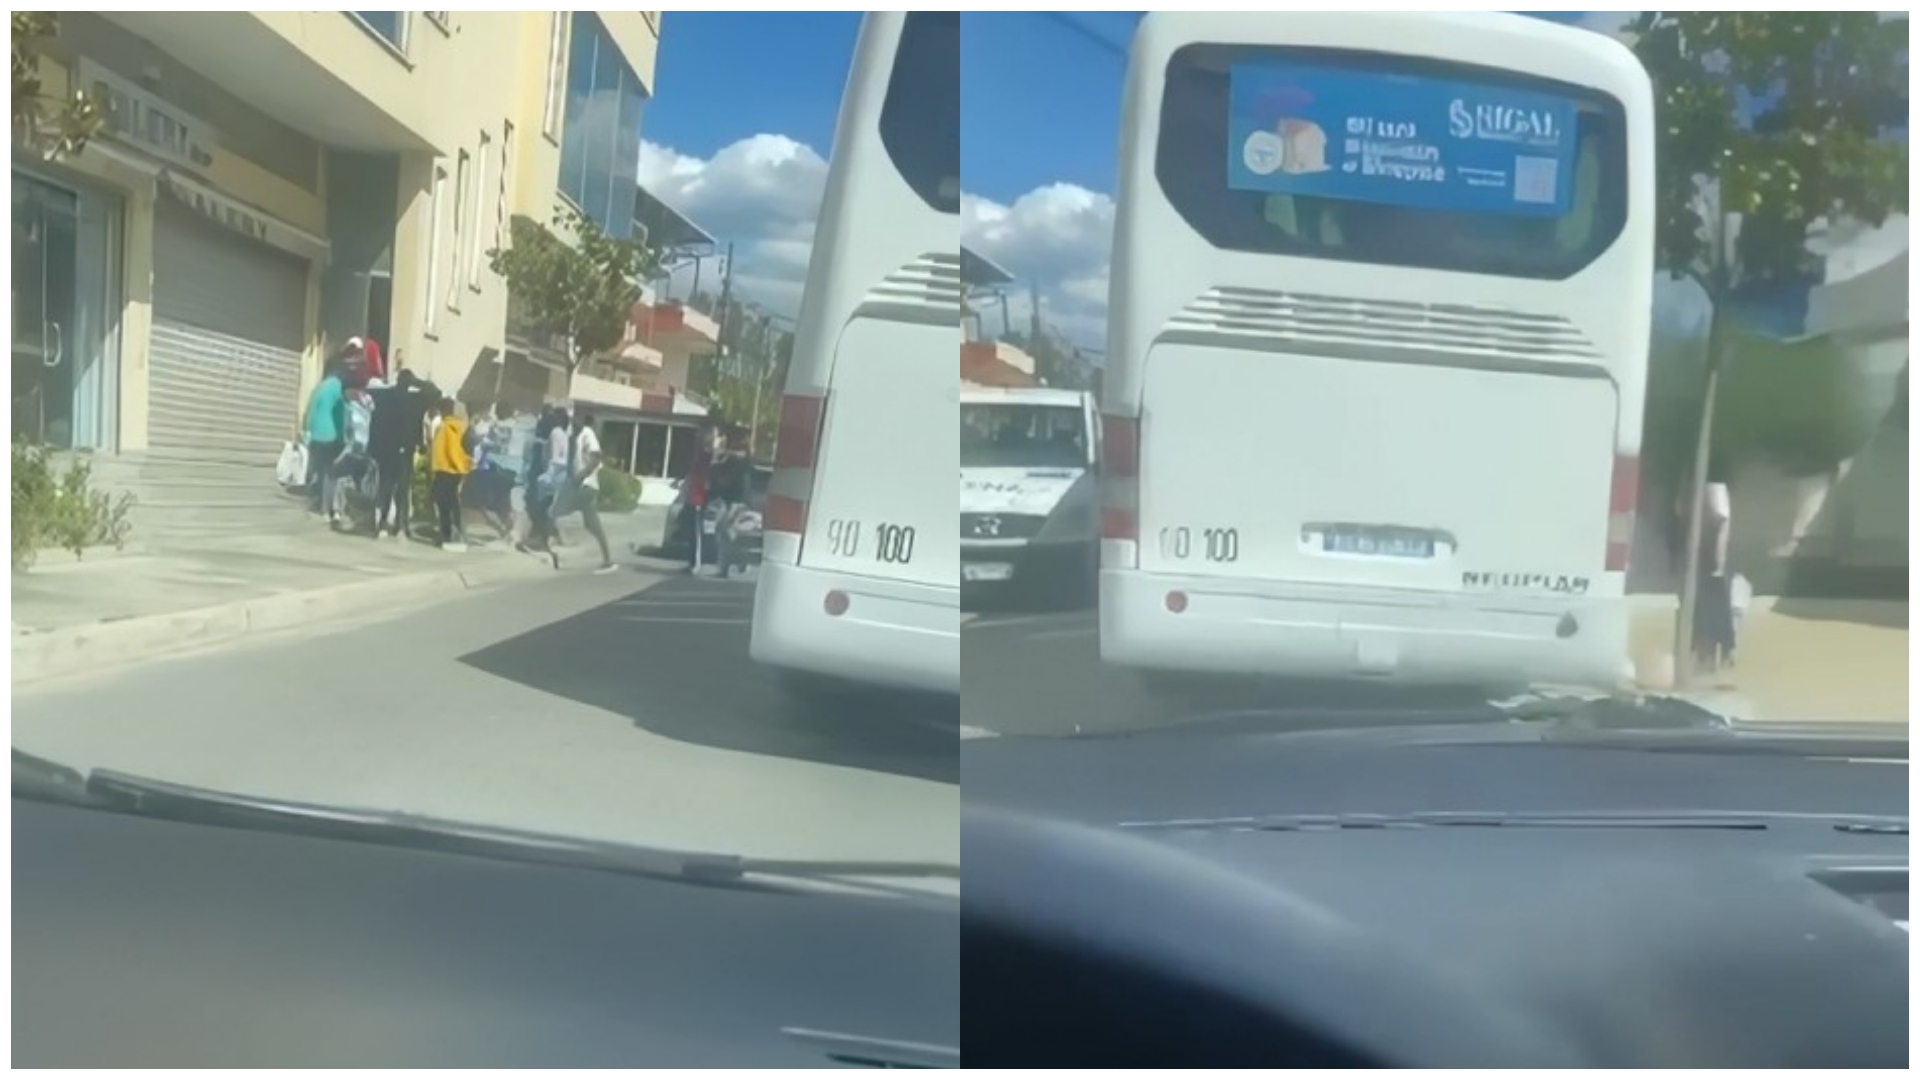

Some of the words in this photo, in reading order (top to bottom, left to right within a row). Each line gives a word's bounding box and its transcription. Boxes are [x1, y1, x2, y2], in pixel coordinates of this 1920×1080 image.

[828, 519, 861, 557] 90
[876, 522, 915, 564] 100
[1203, 527, 1239, 562] 100
